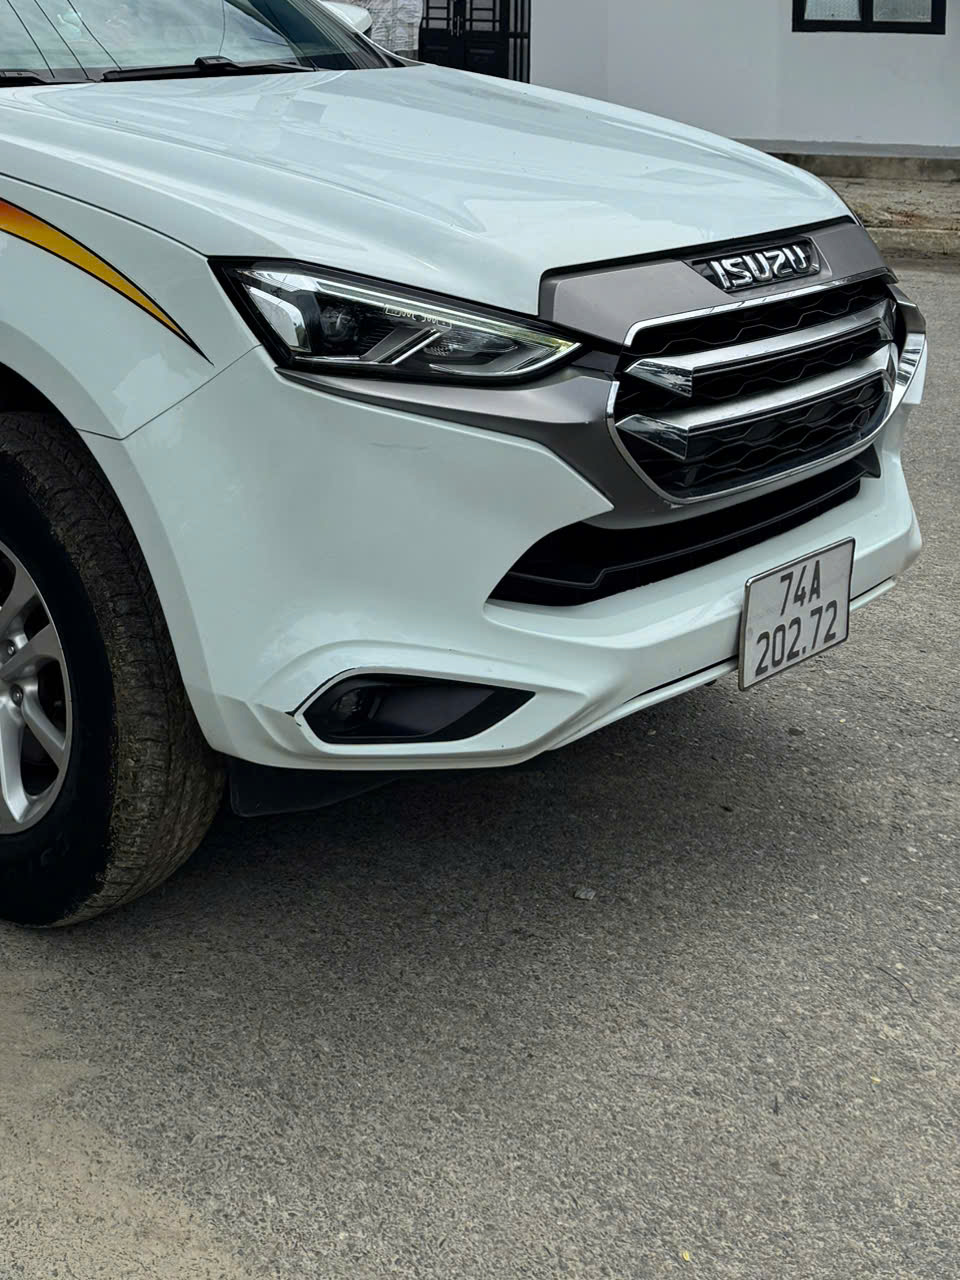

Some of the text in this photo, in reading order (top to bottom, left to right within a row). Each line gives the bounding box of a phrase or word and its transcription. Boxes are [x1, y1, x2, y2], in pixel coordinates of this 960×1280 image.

[710, 245, 808, 289] ISUZU
[780, 559, 821, 616] 74A
[755, 599, 838, 677] 202.72
